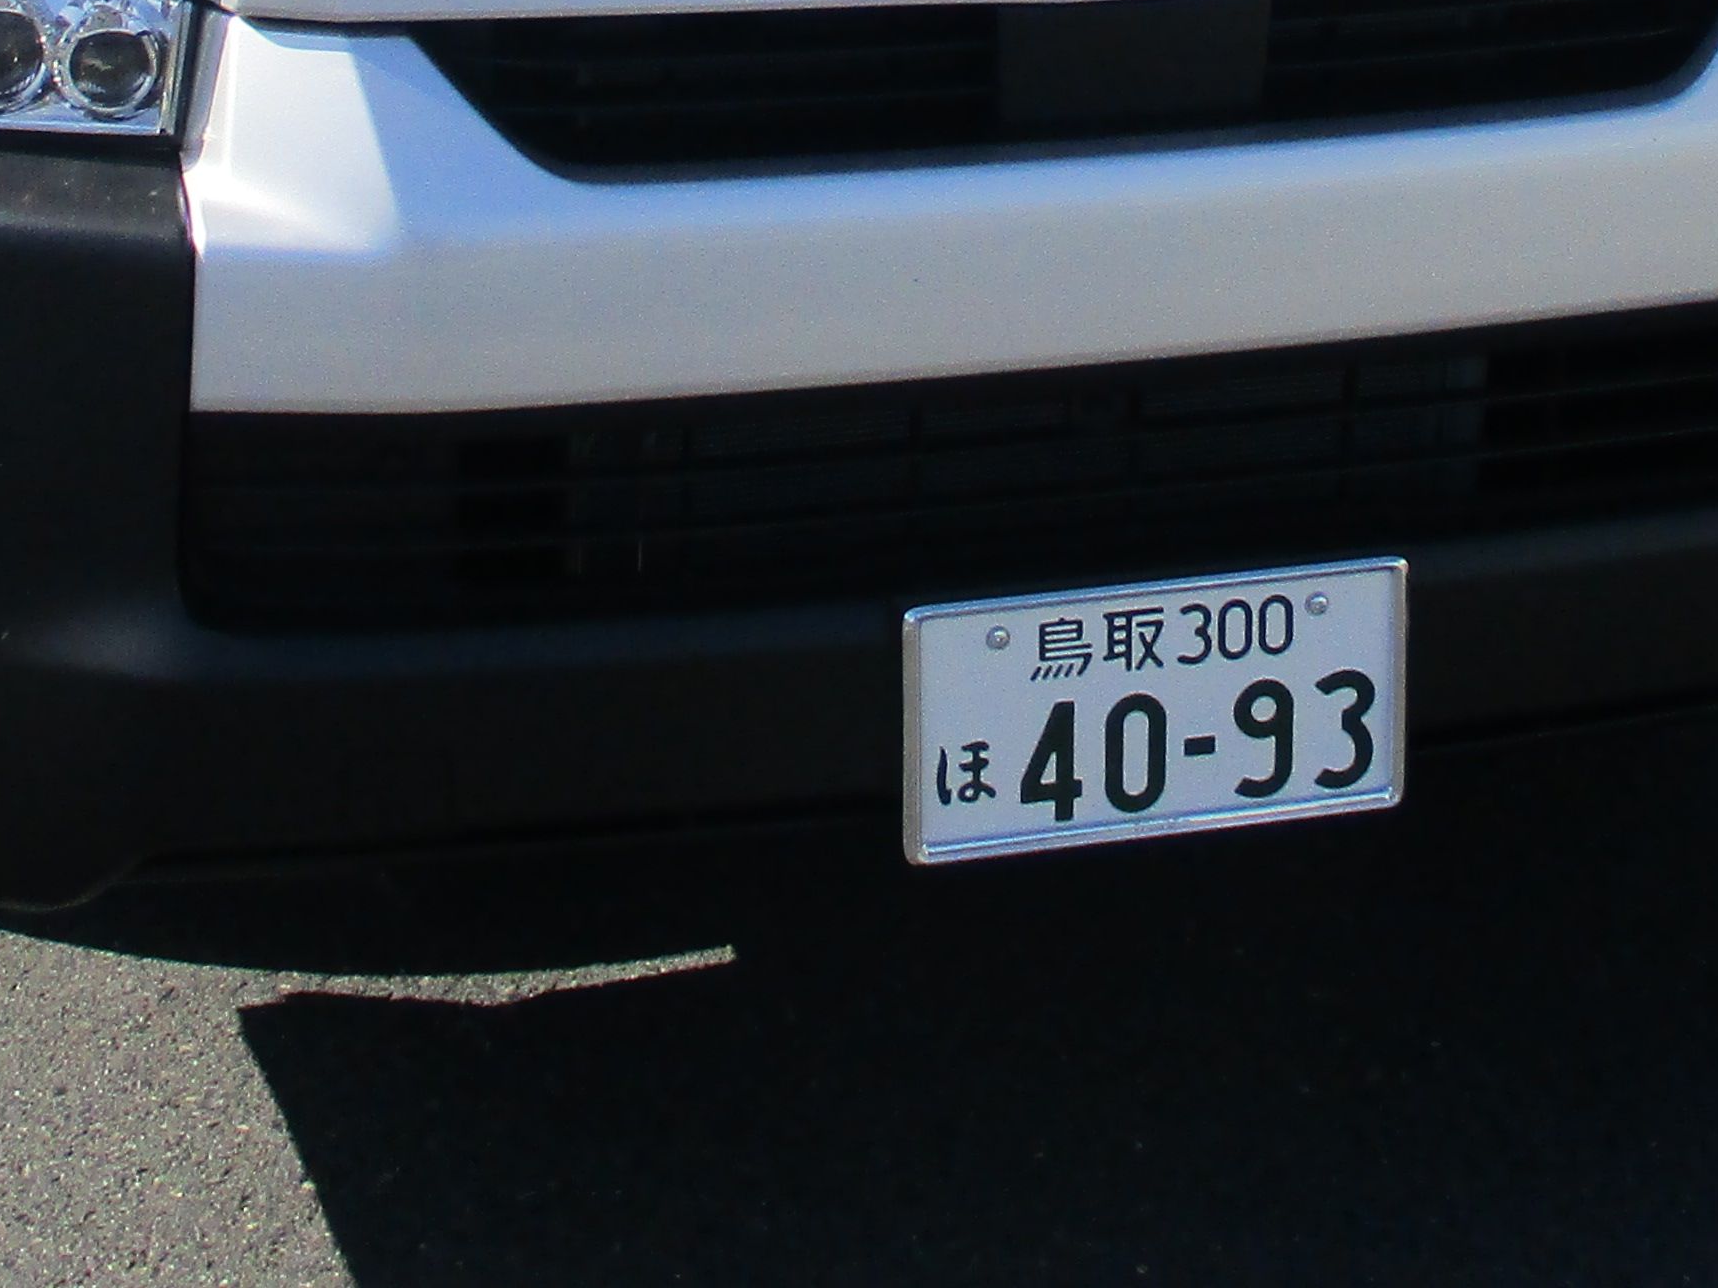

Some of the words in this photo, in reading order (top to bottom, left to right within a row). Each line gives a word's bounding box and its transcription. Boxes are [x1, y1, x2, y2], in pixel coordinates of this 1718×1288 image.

[1030, 594, 1294, 682] 鳥取300
[936, 740, 997, 806] ほ
[1020, 669, 1376, 823] 40-93
